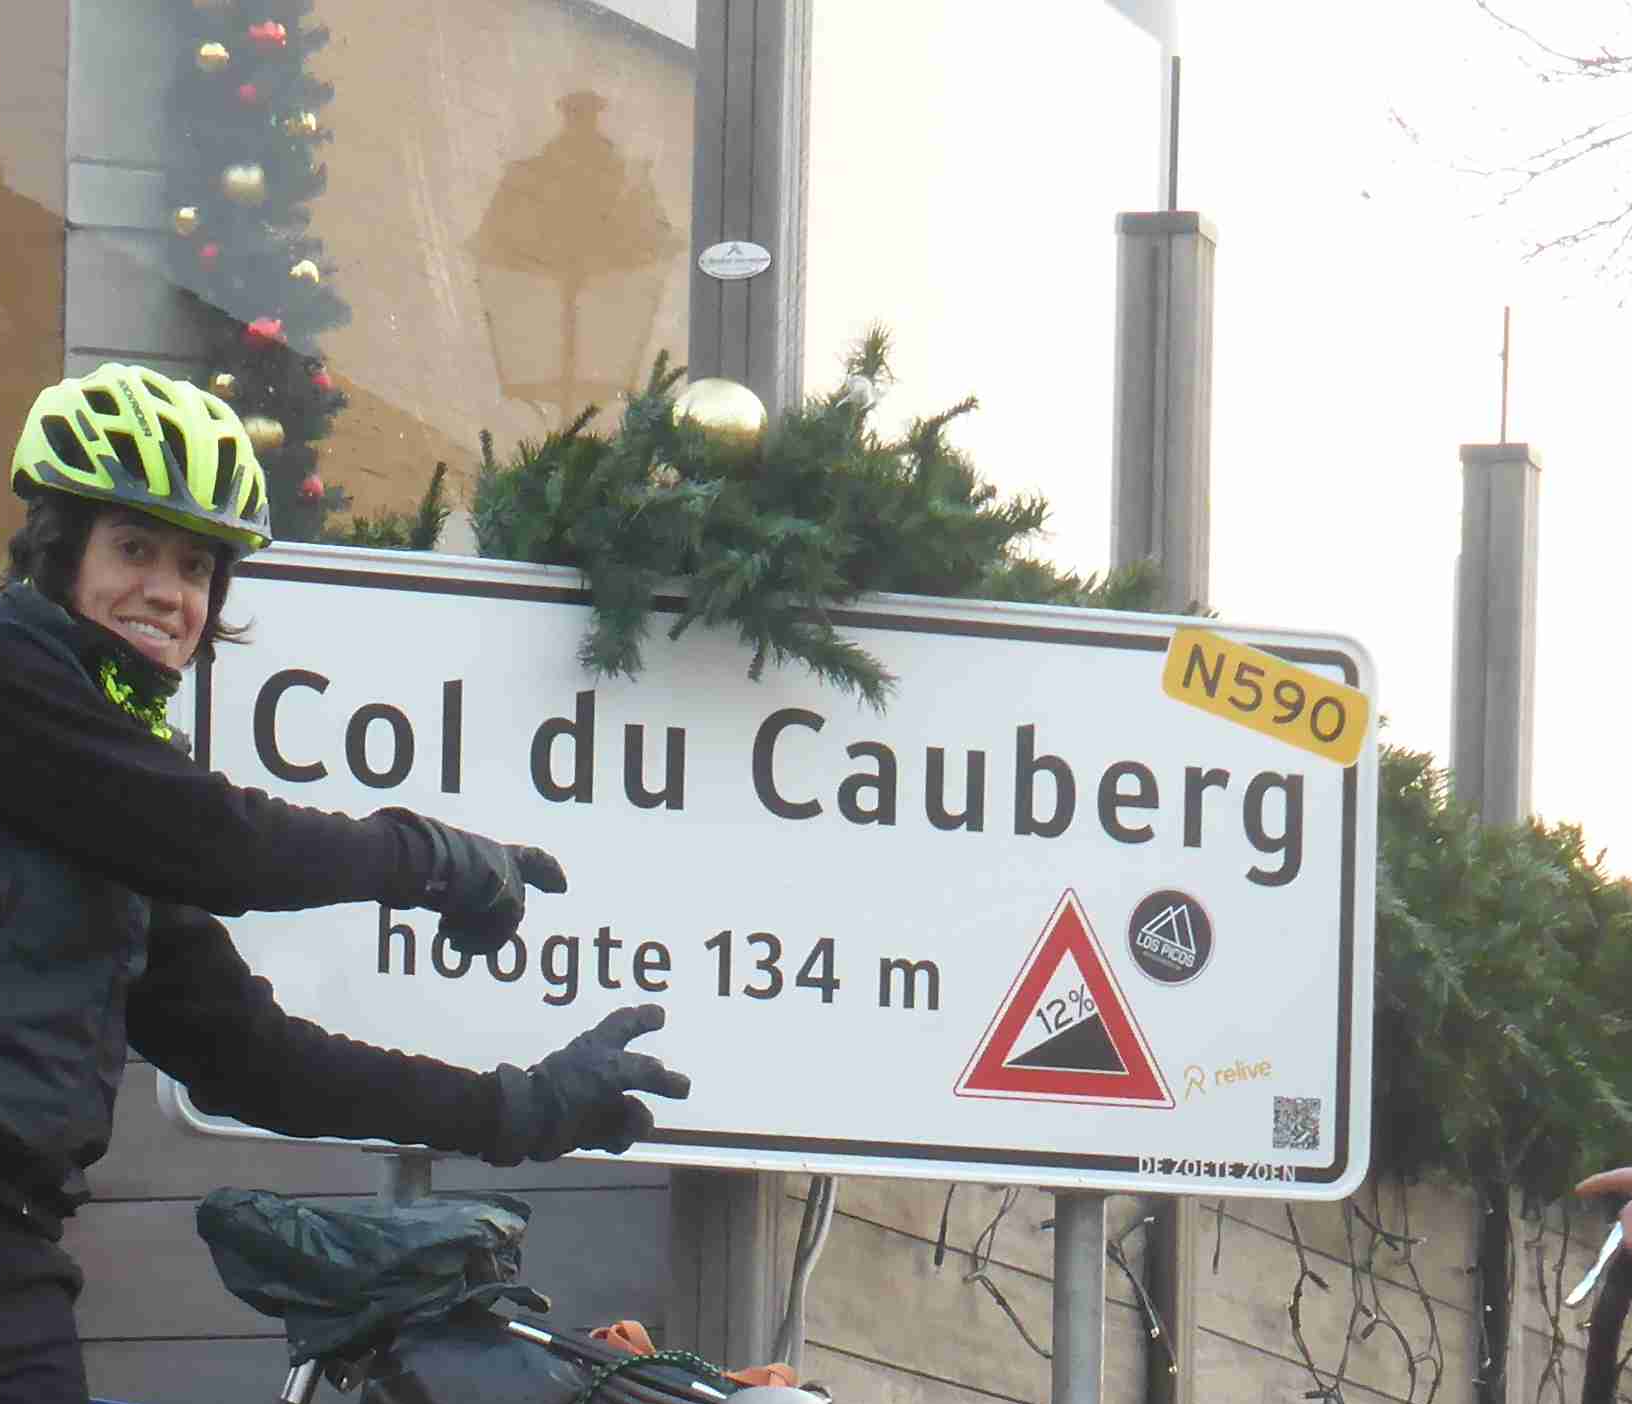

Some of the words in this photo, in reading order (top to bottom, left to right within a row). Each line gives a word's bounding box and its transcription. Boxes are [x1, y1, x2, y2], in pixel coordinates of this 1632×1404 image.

[1182, 643, 1346, 742] N590
[253, 668, 463, 794] Col
[529, 690, 686, 811] du
[751, 707, 1305, 887] Cauberg
[377, 904, 672, 1006] hoogte
[704, 929, 840, 1004] 134
[878, 955, 941, 1011] m
[1136, 932, 1161, 953] LOS
[1160, 943, 1195, 968] PICOS
[1036, 983, 1094, 1034] 12%
[1214, 1056, 1273, 1087] relive
[1138, 1156, 1163, 1174] DE
[1172, 1159, 1233, 1179] ZOETE
[1242, 1163, 1296, 1183] ZOEN
